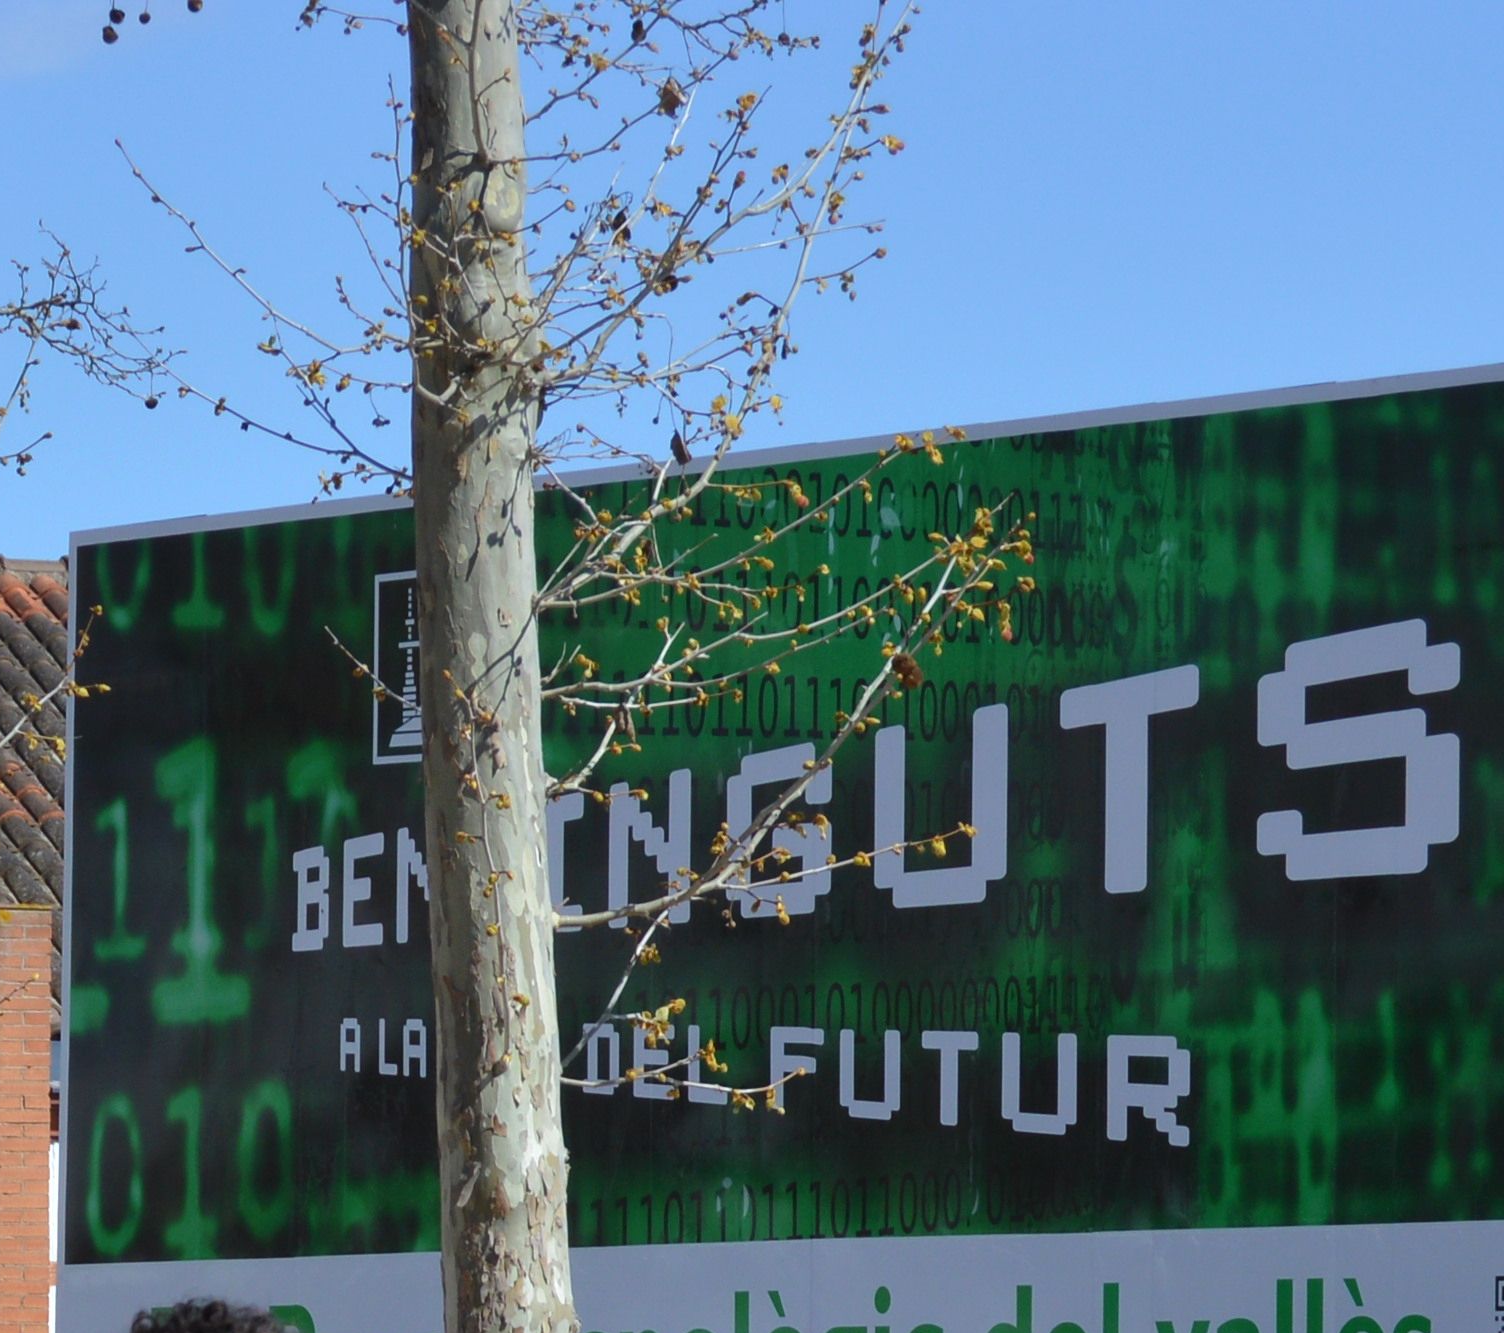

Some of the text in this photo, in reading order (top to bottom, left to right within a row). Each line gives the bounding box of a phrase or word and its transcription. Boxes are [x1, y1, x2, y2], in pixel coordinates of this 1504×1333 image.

[292, 617, 1461, 952] BENINGUTS
[339, 1018, 1191, 1147] A LA DEL FUTUR
